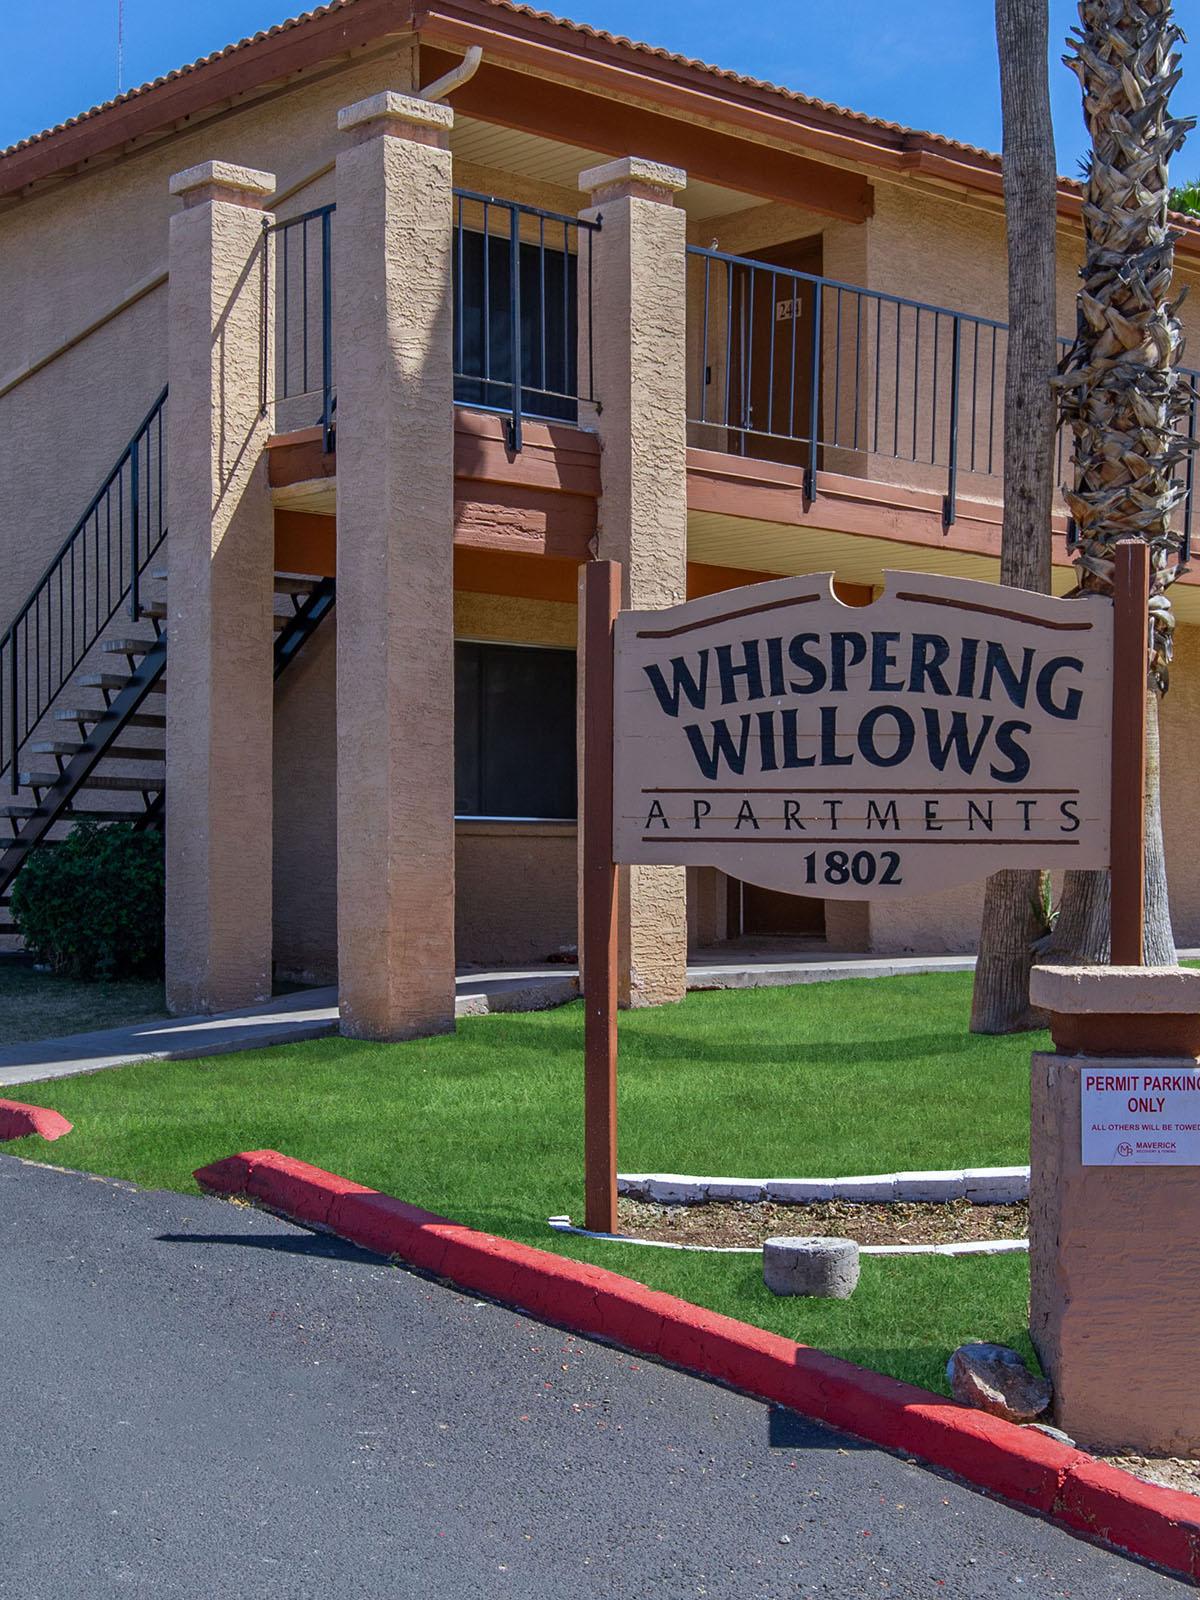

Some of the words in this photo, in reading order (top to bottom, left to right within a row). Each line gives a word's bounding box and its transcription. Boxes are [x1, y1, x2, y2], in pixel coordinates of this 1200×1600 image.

[643, 631, 1084, 720] WHISPERING
[683, 705, 1032, 783] WILLOWS
[645, 800, 1080, 831] APARTMENTS
[803, 850, 903, 885] 1802
[1086, 1076, 1139, 1092] PERMIT
[1128, 1097, 1165, 1113] ONLY
